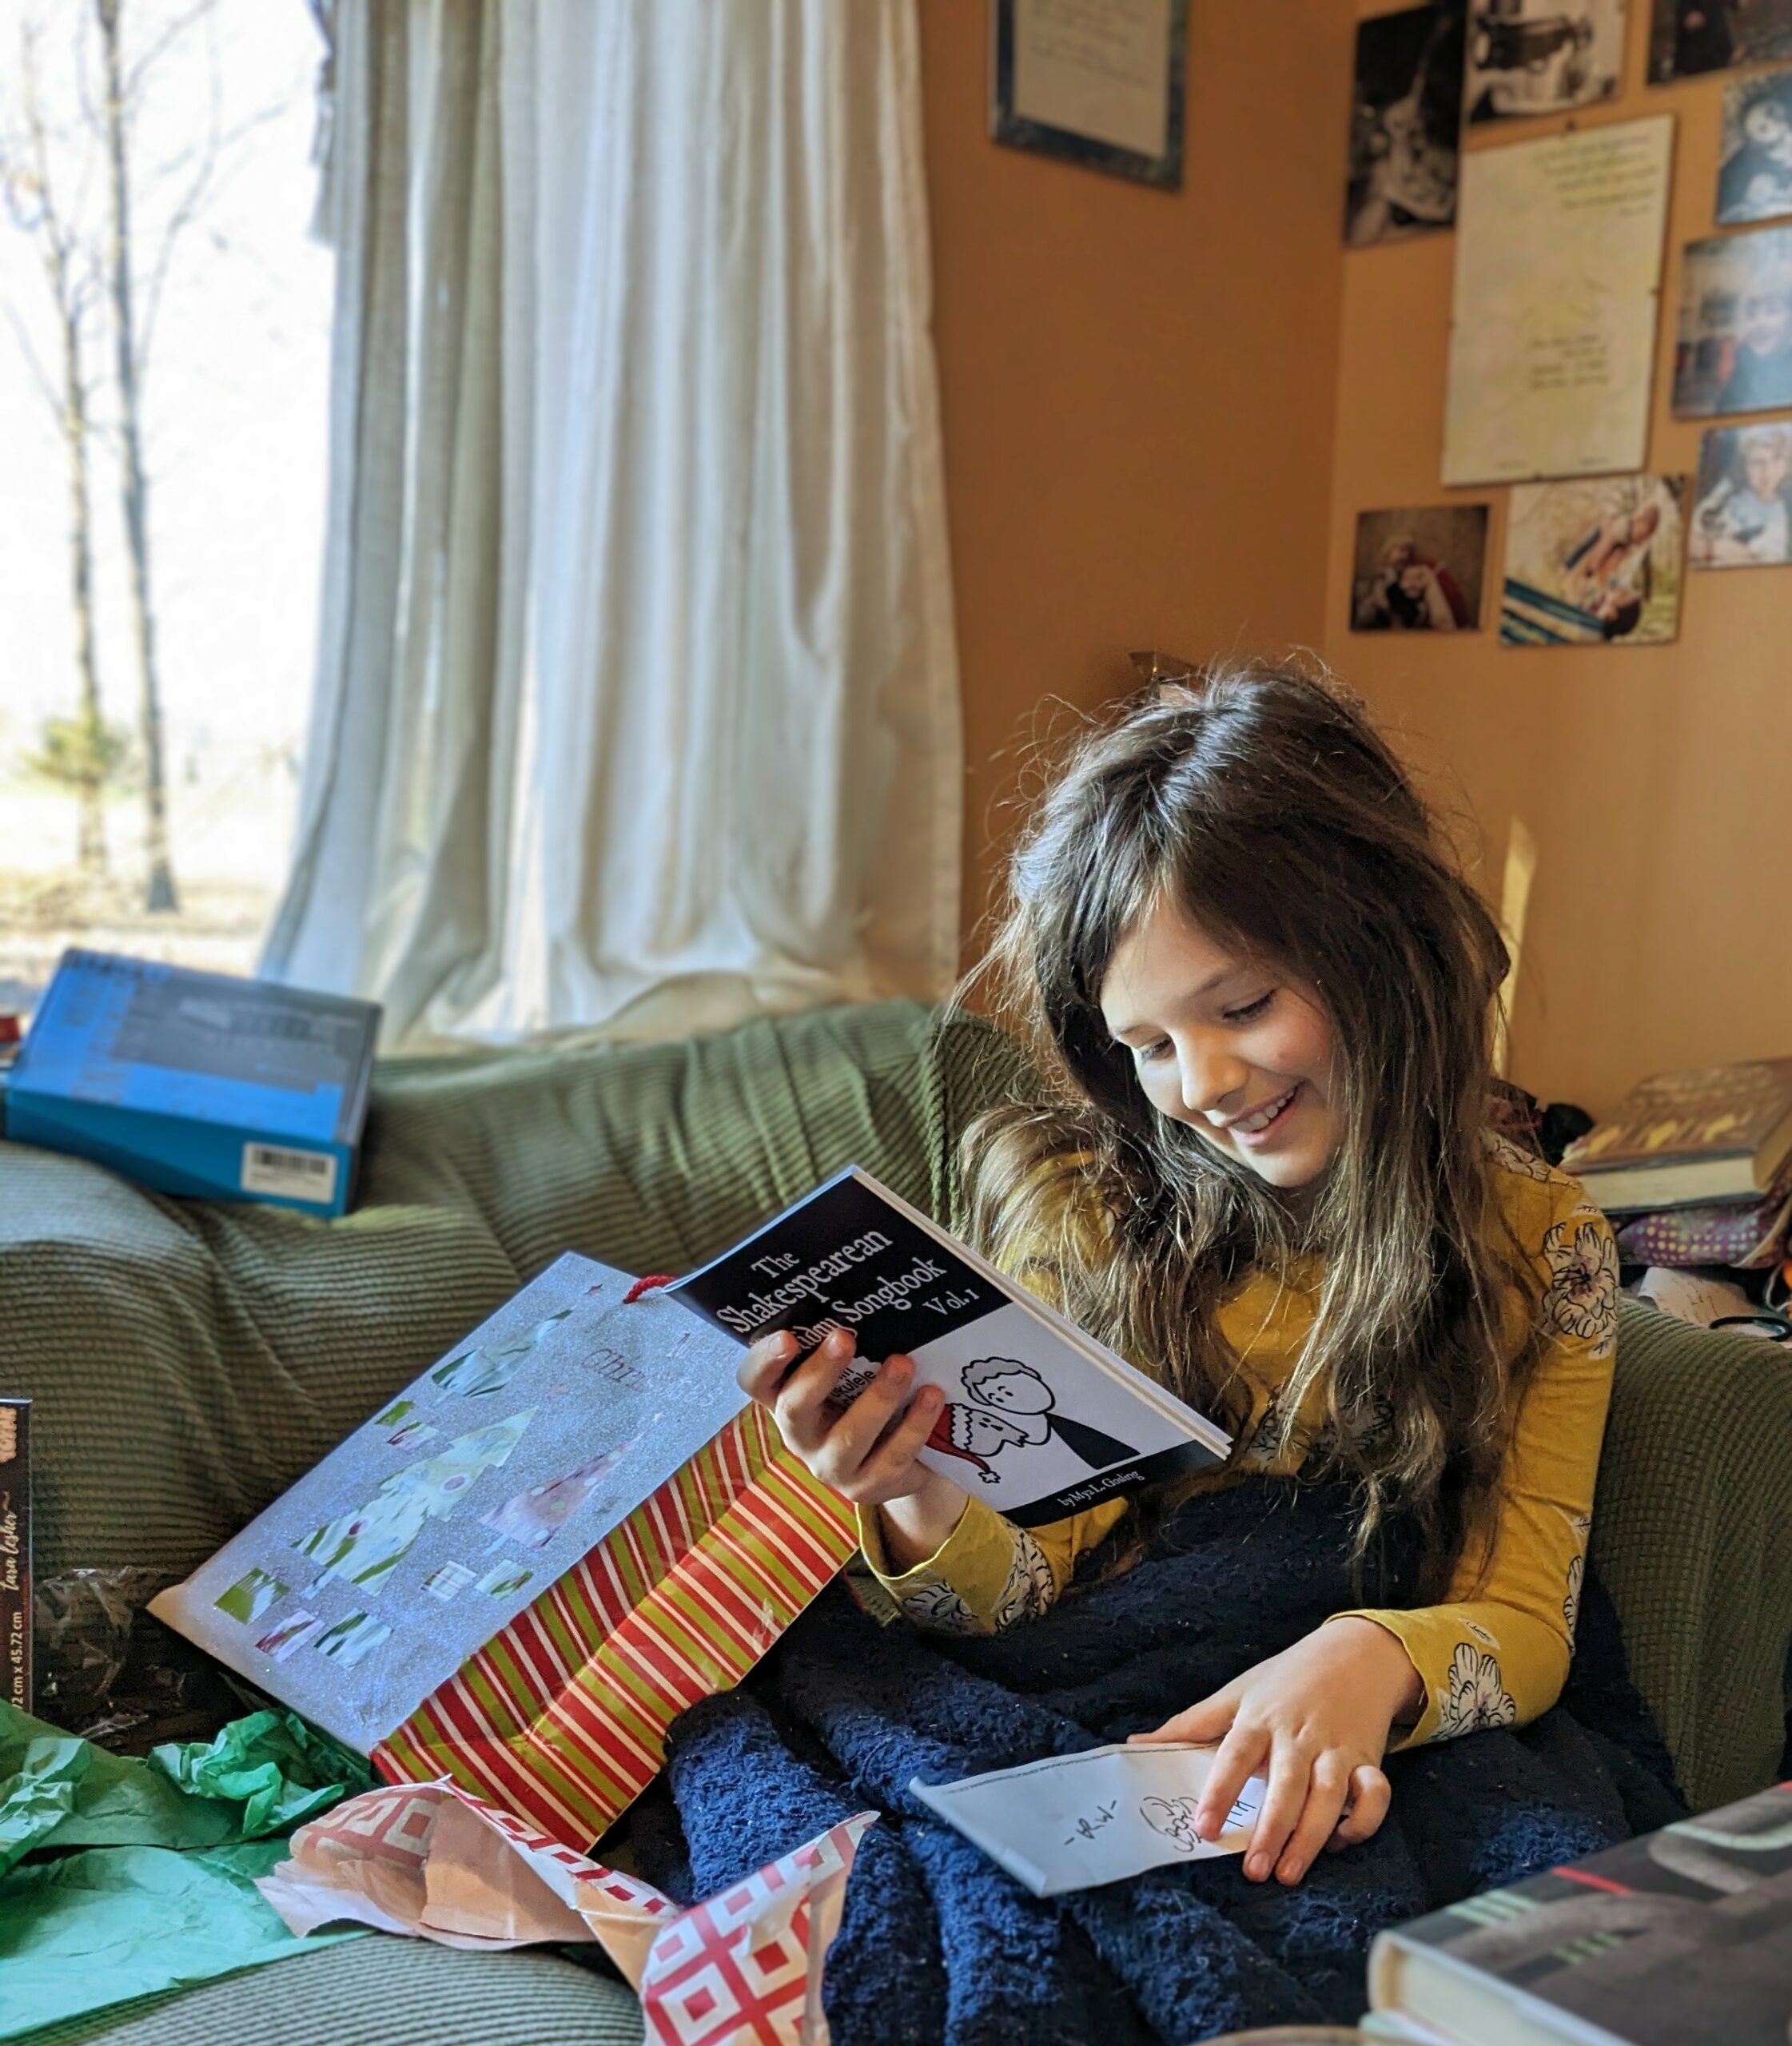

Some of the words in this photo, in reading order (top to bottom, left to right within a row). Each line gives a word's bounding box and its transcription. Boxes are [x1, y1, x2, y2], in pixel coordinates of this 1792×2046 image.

[751, 1252, 800, 1279] The
[716, 1229, 894, 1333] Shakespearean
[832, 1256, 947, 1324] Songbook
[922, 1291, 970, 1316] Vol.
[830, 1371, 877, 1398] ukulele
[1057, 1498, 1076, 1507] by
[1069, 1489, 1095, 1502] Mya
[1088, 1484, 1106, 1493] L.
[1101, 1470, 1145, 1488] Gosling
[13, 1611, 22, 1630] cm
[10, 1632, 23, 1664] 45.72
[14, 1666, 23, 1674] x
[14, 1677, 23, 1694] cm
